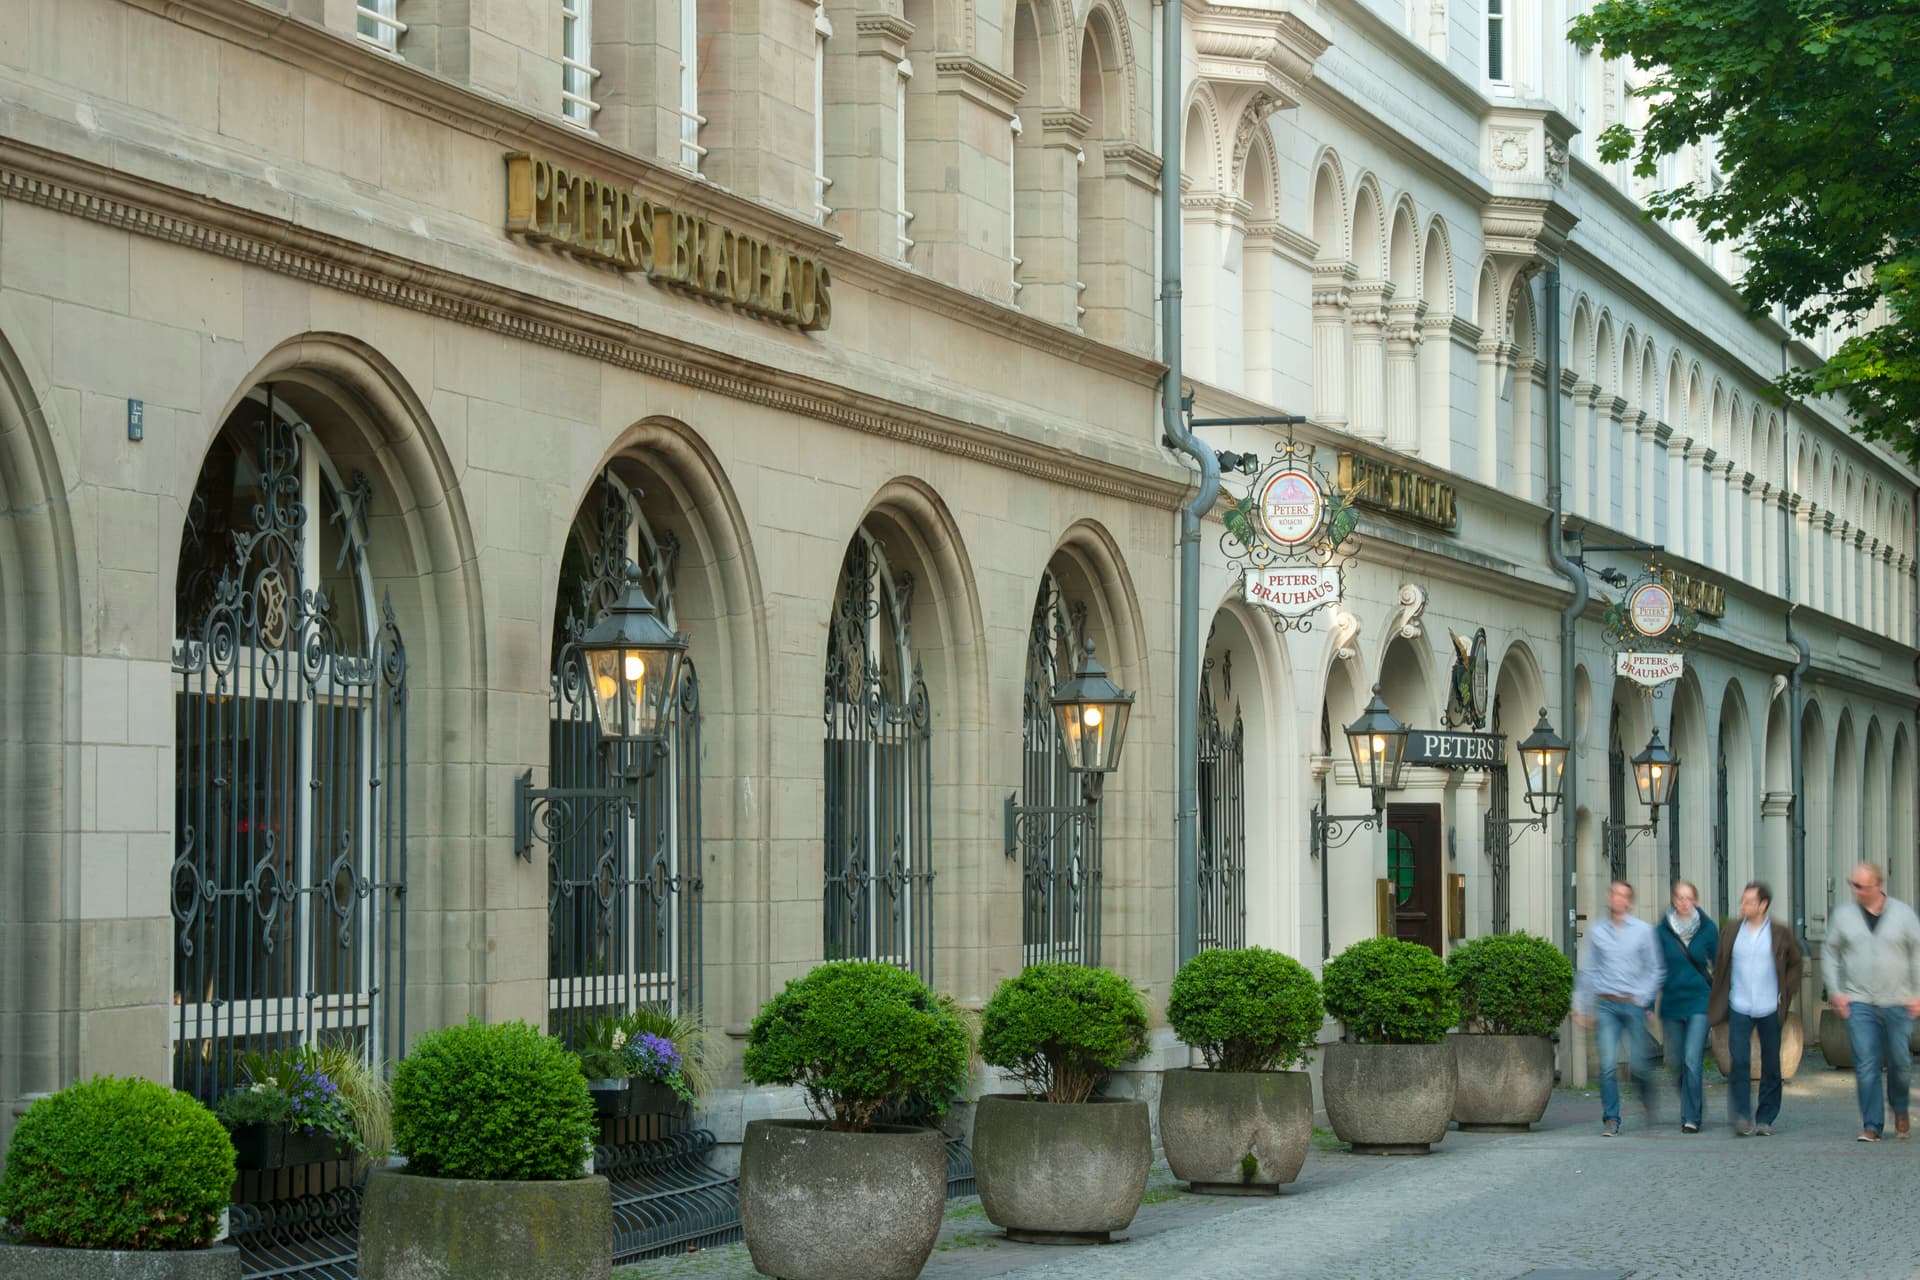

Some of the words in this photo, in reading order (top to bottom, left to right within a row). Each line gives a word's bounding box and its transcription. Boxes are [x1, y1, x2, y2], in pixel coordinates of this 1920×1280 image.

[528, 154, 656, 272] PETERS
[668, 209, 832, 330] BRAUHAUS
[1273, 504, 1309, 515] PETERS
[1269, 575, 1317, 586] PETERS
[1251, 581, 1333, 604] BRAUHAUS
[1621, 661, 1680, 678] BRAUHAUS
[1633, 656, 1669, 666] PETERS
[1423, 735, 1494, 760] PETERS
